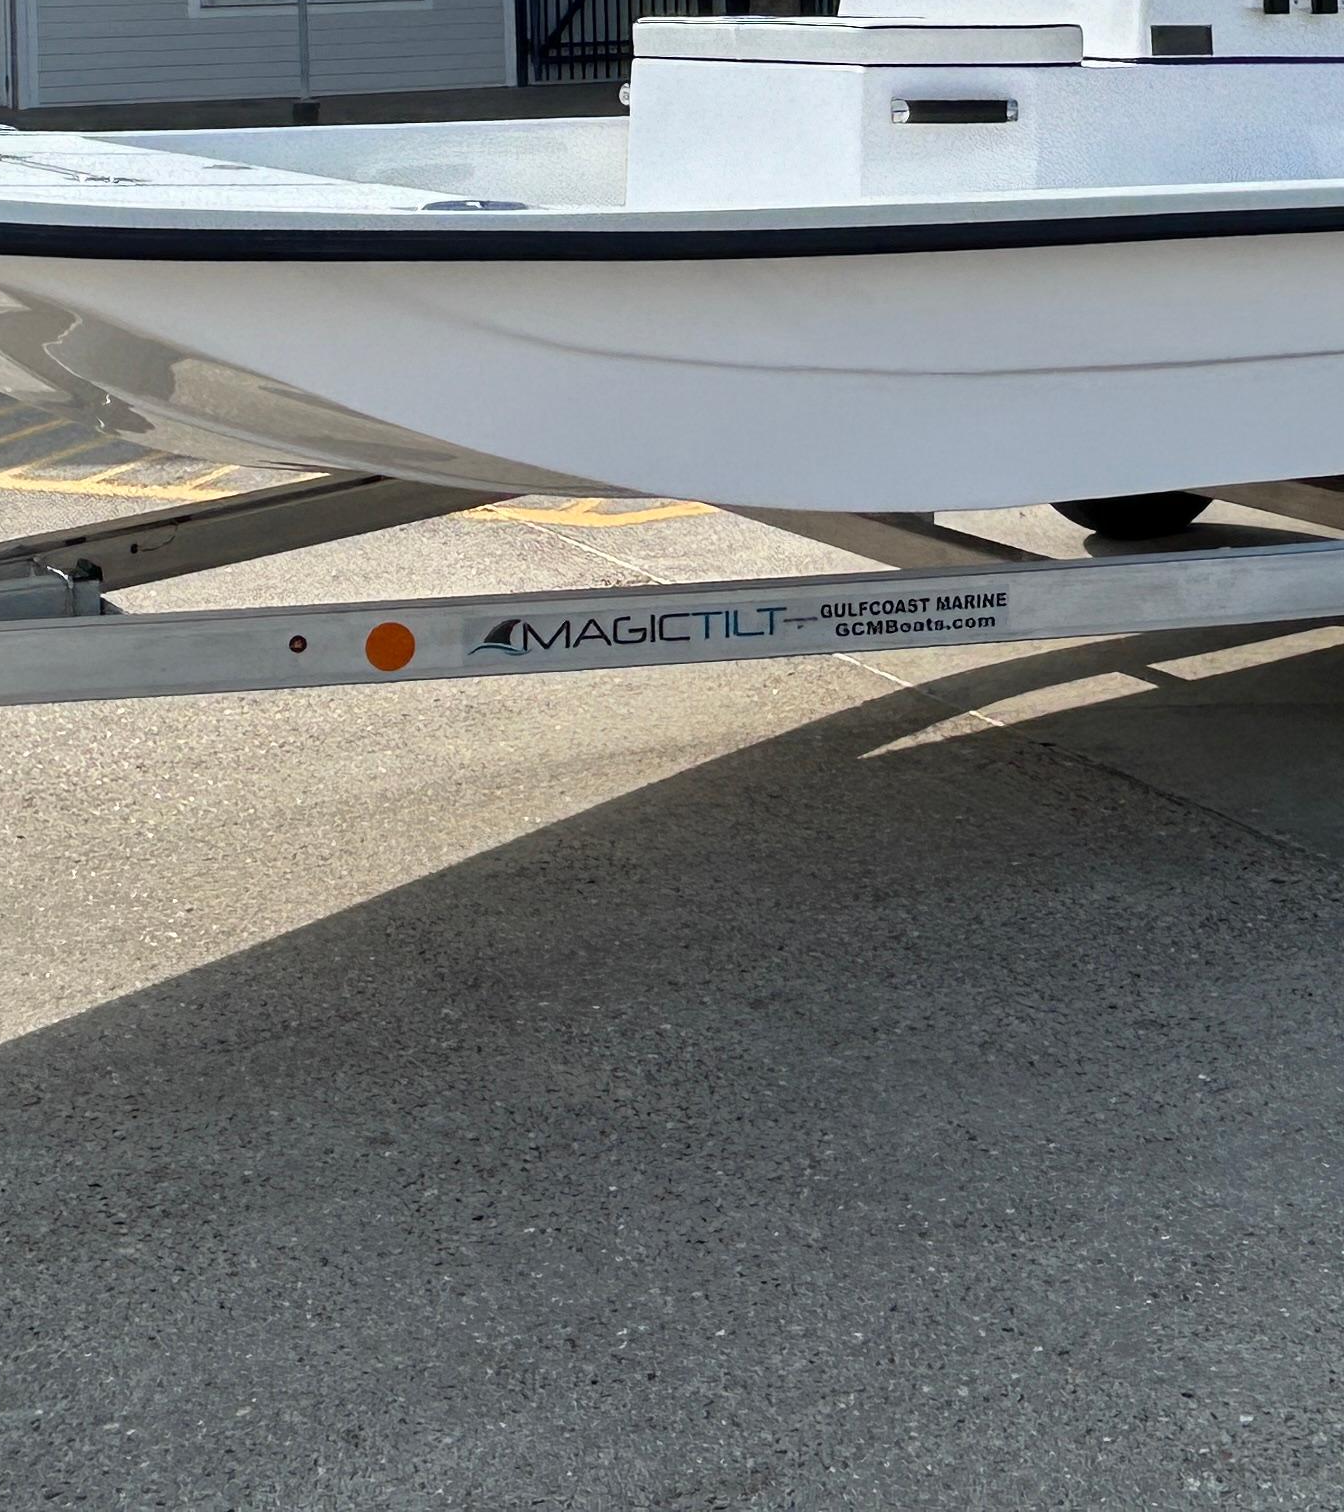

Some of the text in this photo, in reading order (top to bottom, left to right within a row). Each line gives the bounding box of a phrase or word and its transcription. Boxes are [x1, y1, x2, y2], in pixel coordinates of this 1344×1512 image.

[820, 592, 1008, 619] GULFCOAST MARINE
[522, 606, 787, 650] MAGICTILT
[835, 615, 996, 637] GCMBoats.com
